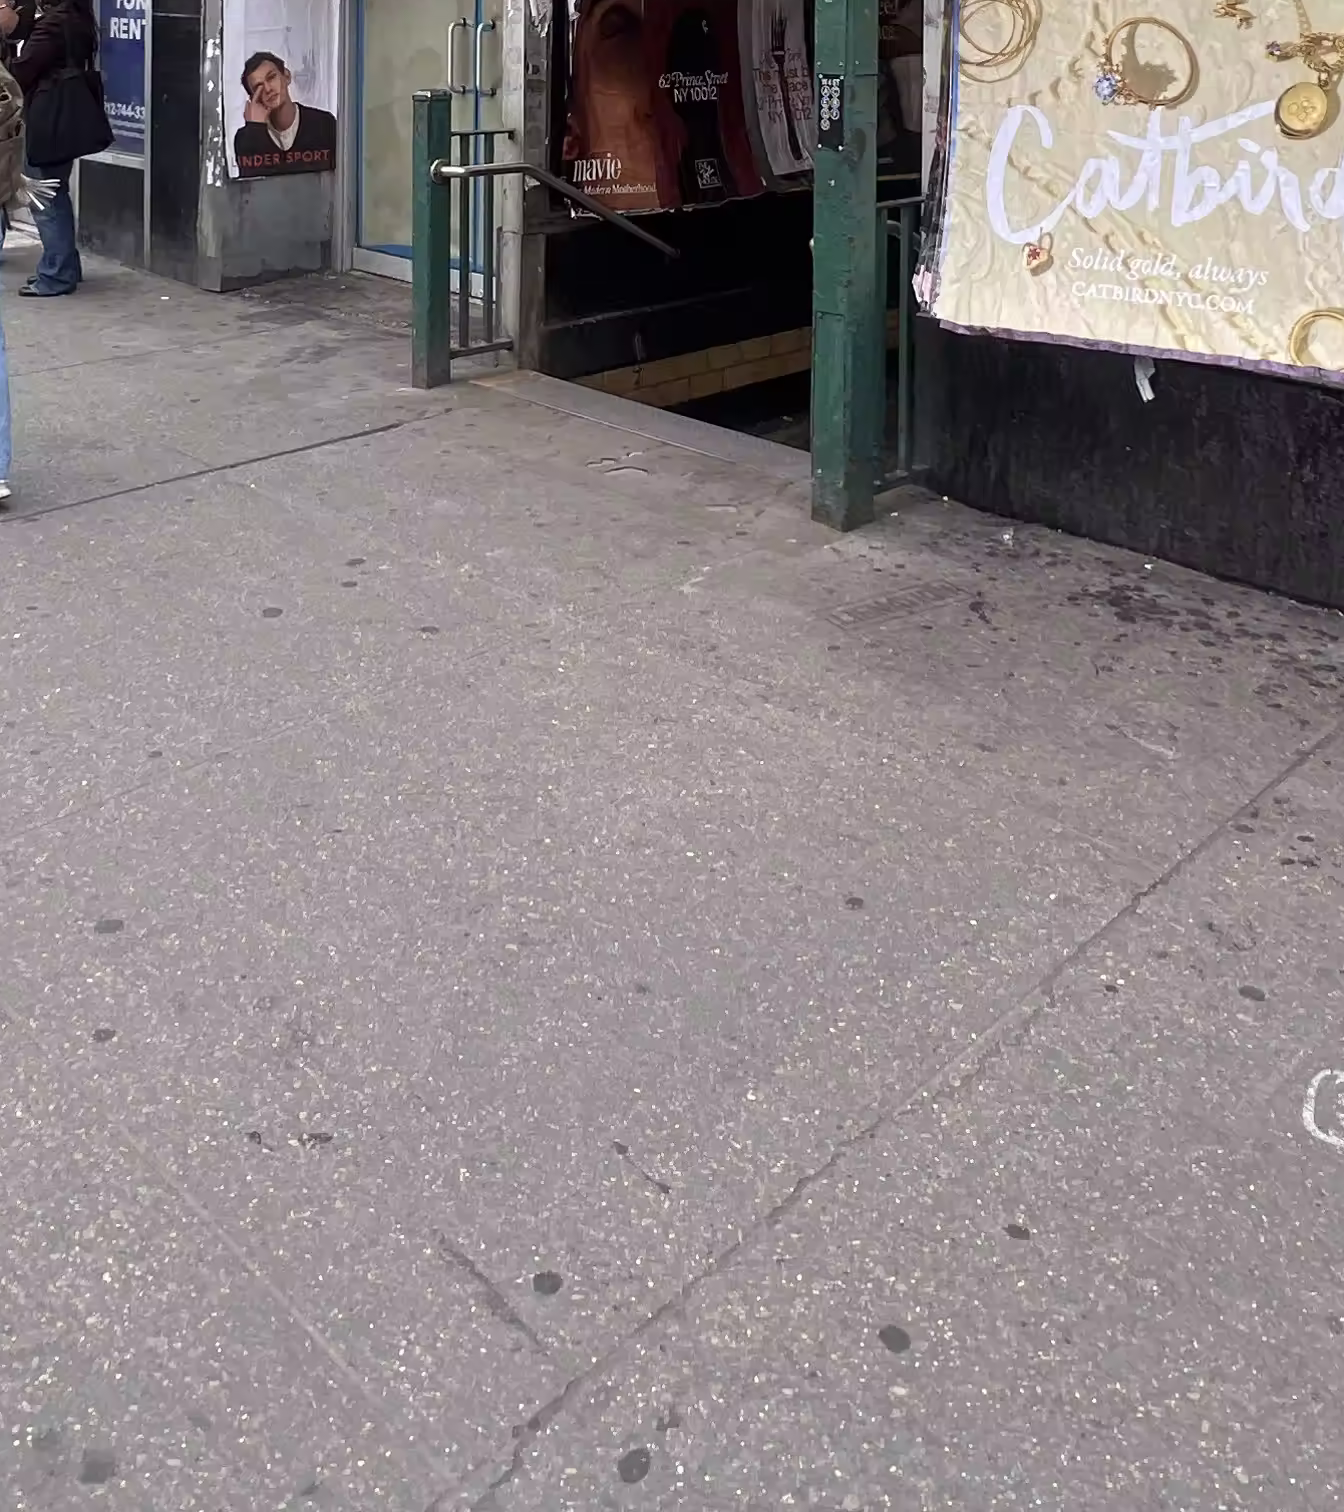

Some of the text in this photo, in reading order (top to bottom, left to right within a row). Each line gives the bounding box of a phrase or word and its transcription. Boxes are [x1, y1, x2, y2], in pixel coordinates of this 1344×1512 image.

[658, 70, 729, 88] 62 Prince Street
[674, 87, 718, 103] NY 10012
[286, 149, 330, 163] SPORT
[573, 153, 622, 183] mavie
[1067, 247, 1270, 288] Solid gold, always
[1071, 280, 1255, 315] CATBIRDNYC.COM
